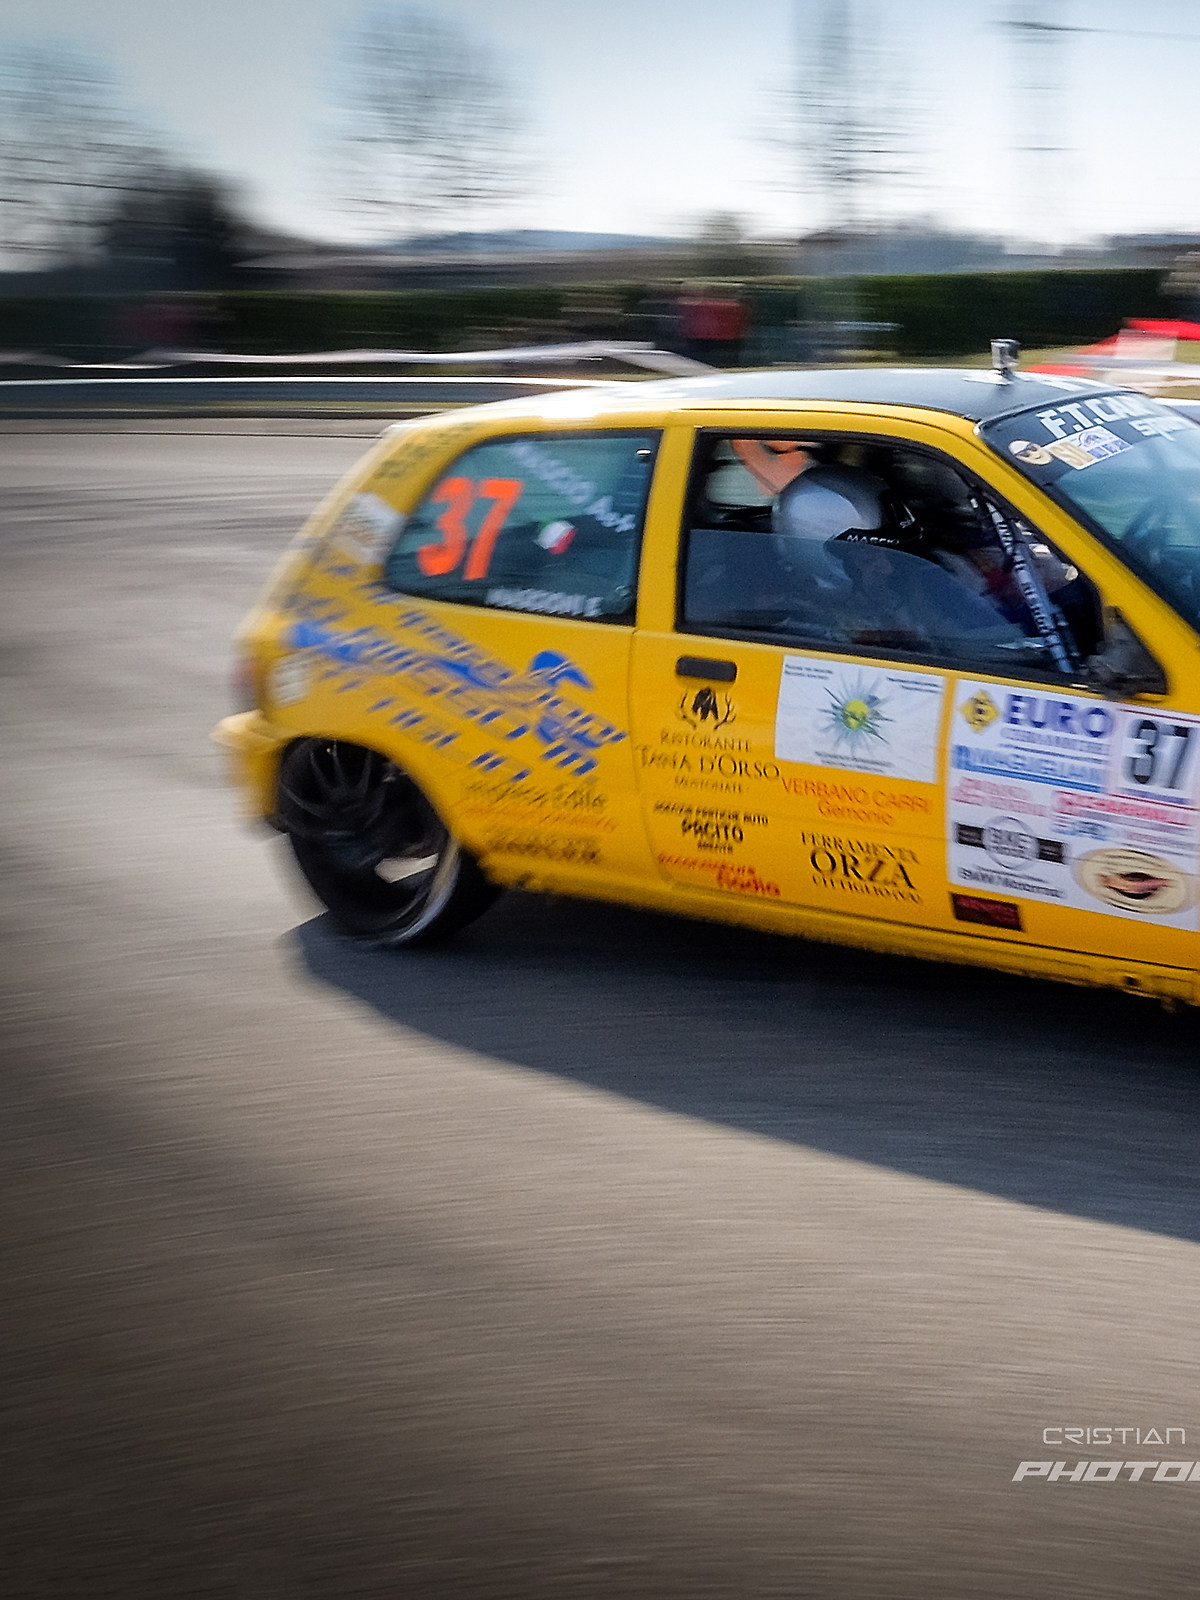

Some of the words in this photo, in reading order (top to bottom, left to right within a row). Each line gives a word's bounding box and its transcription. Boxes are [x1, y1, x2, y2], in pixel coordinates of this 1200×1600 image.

[416, 476, 525, 581] 37
[1002, 693, 1115, 738] EURO
[1127, 719, 1194, 790] 37
[781, 776, 870, 806] VERBANO
[810, 847, 918, 891] ORZA
